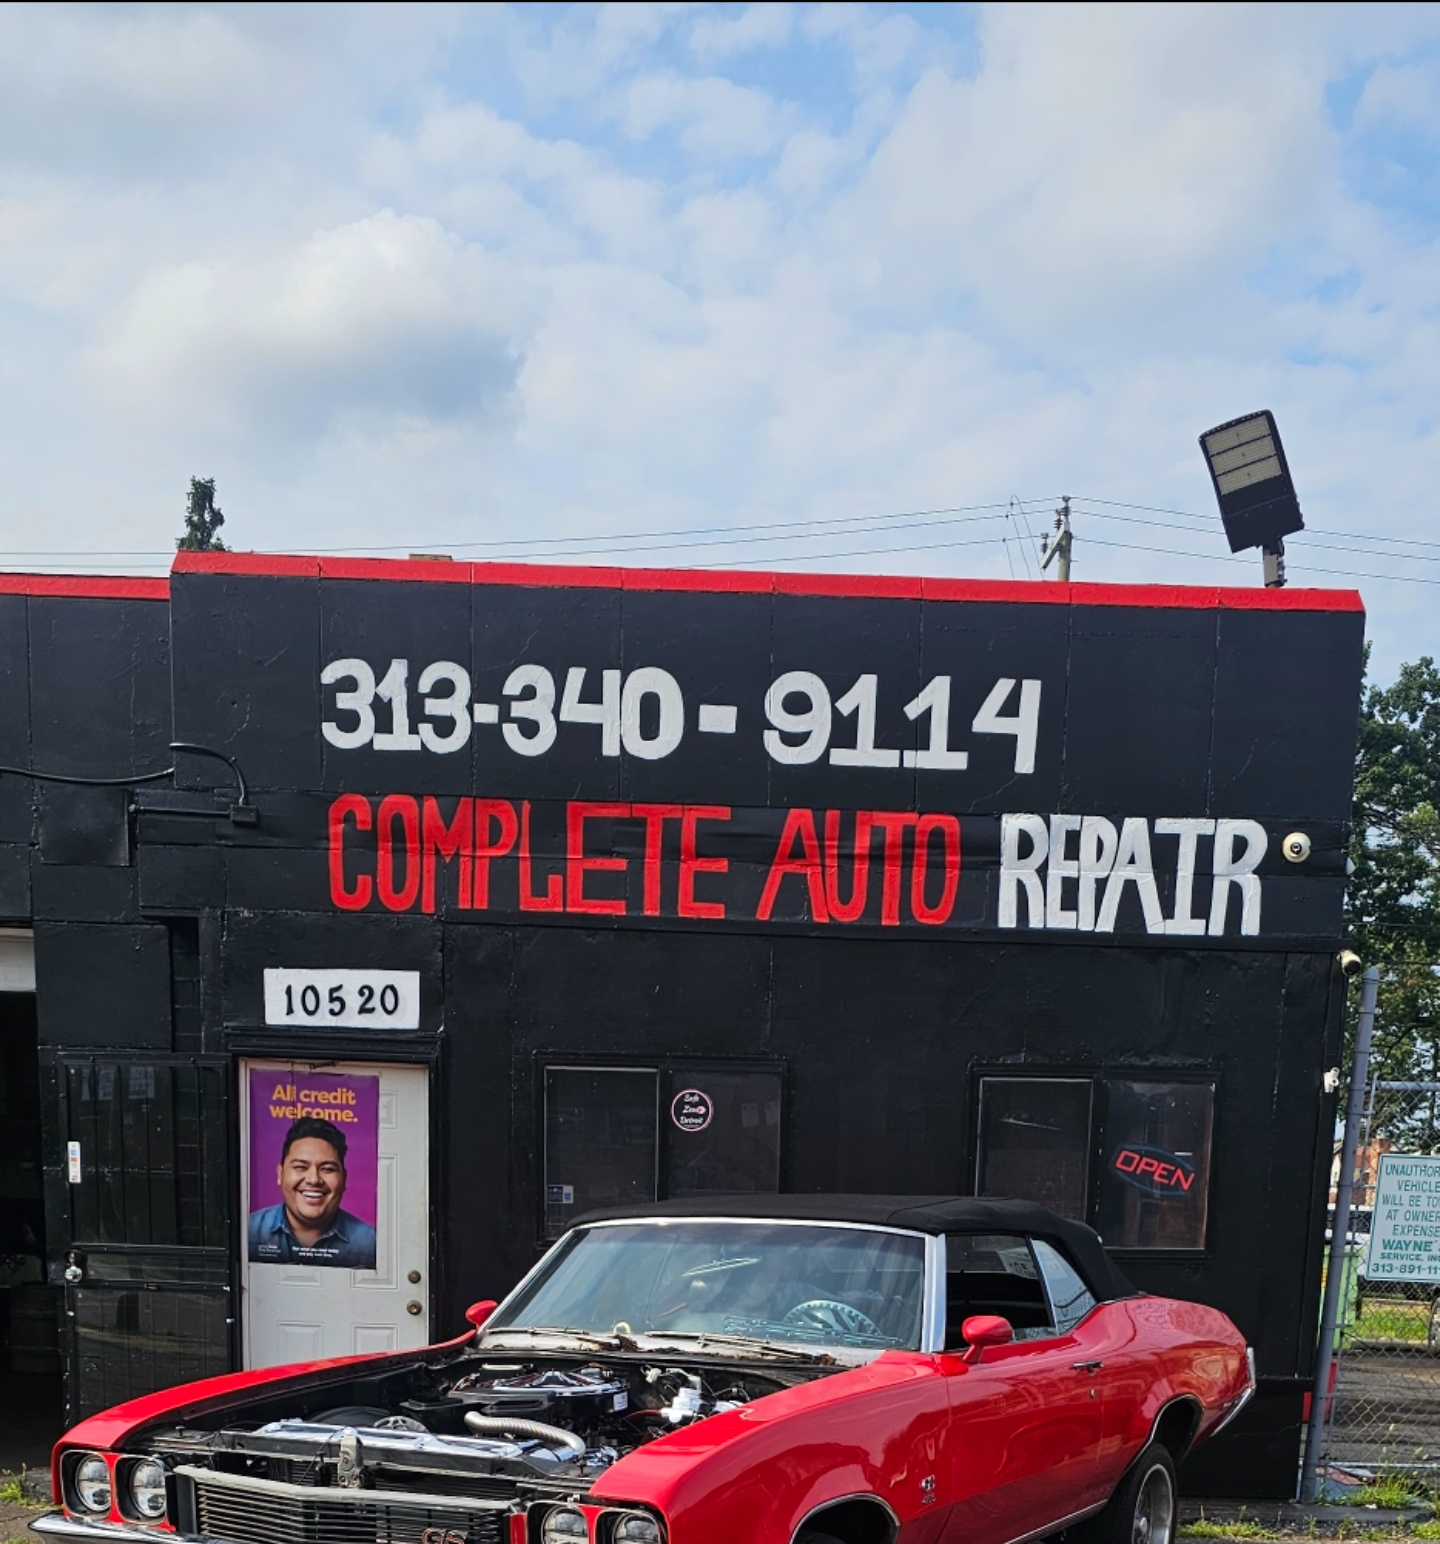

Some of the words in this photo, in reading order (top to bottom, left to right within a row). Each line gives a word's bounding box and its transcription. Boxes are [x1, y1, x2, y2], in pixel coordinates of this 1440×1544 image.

[321, 658, 685, 760] 313-340
[763, 670, 1042, 774] 9114
[328, 793, 732, 918] COMPLETE
[755, 808, 961, 926] AUTO
[997, 812, 1268, 936] REPAIR
[285, 983, 400, 1017] 10520
[272, 1084, 297, 1102] All
[299, 1087, 357, 1106] credit
[269, 1103, 359, 1123] welcome.
[1115, 1150, 1195, 1190] OPEN
[1382, 1193, 1404, 1205] WILL
[1409, 1195, 1422, 1207] BE
[1386, 1209, 1399, 1221] AT
[1392, 1223, 1440, 1238] EXPENSE
[1382, 1239, 1440, 1252] WAYNE'
[1379, 1252, 1423, 1264] SERVICE,
[1371, 1263, 1440, 1276] 313-891-11
